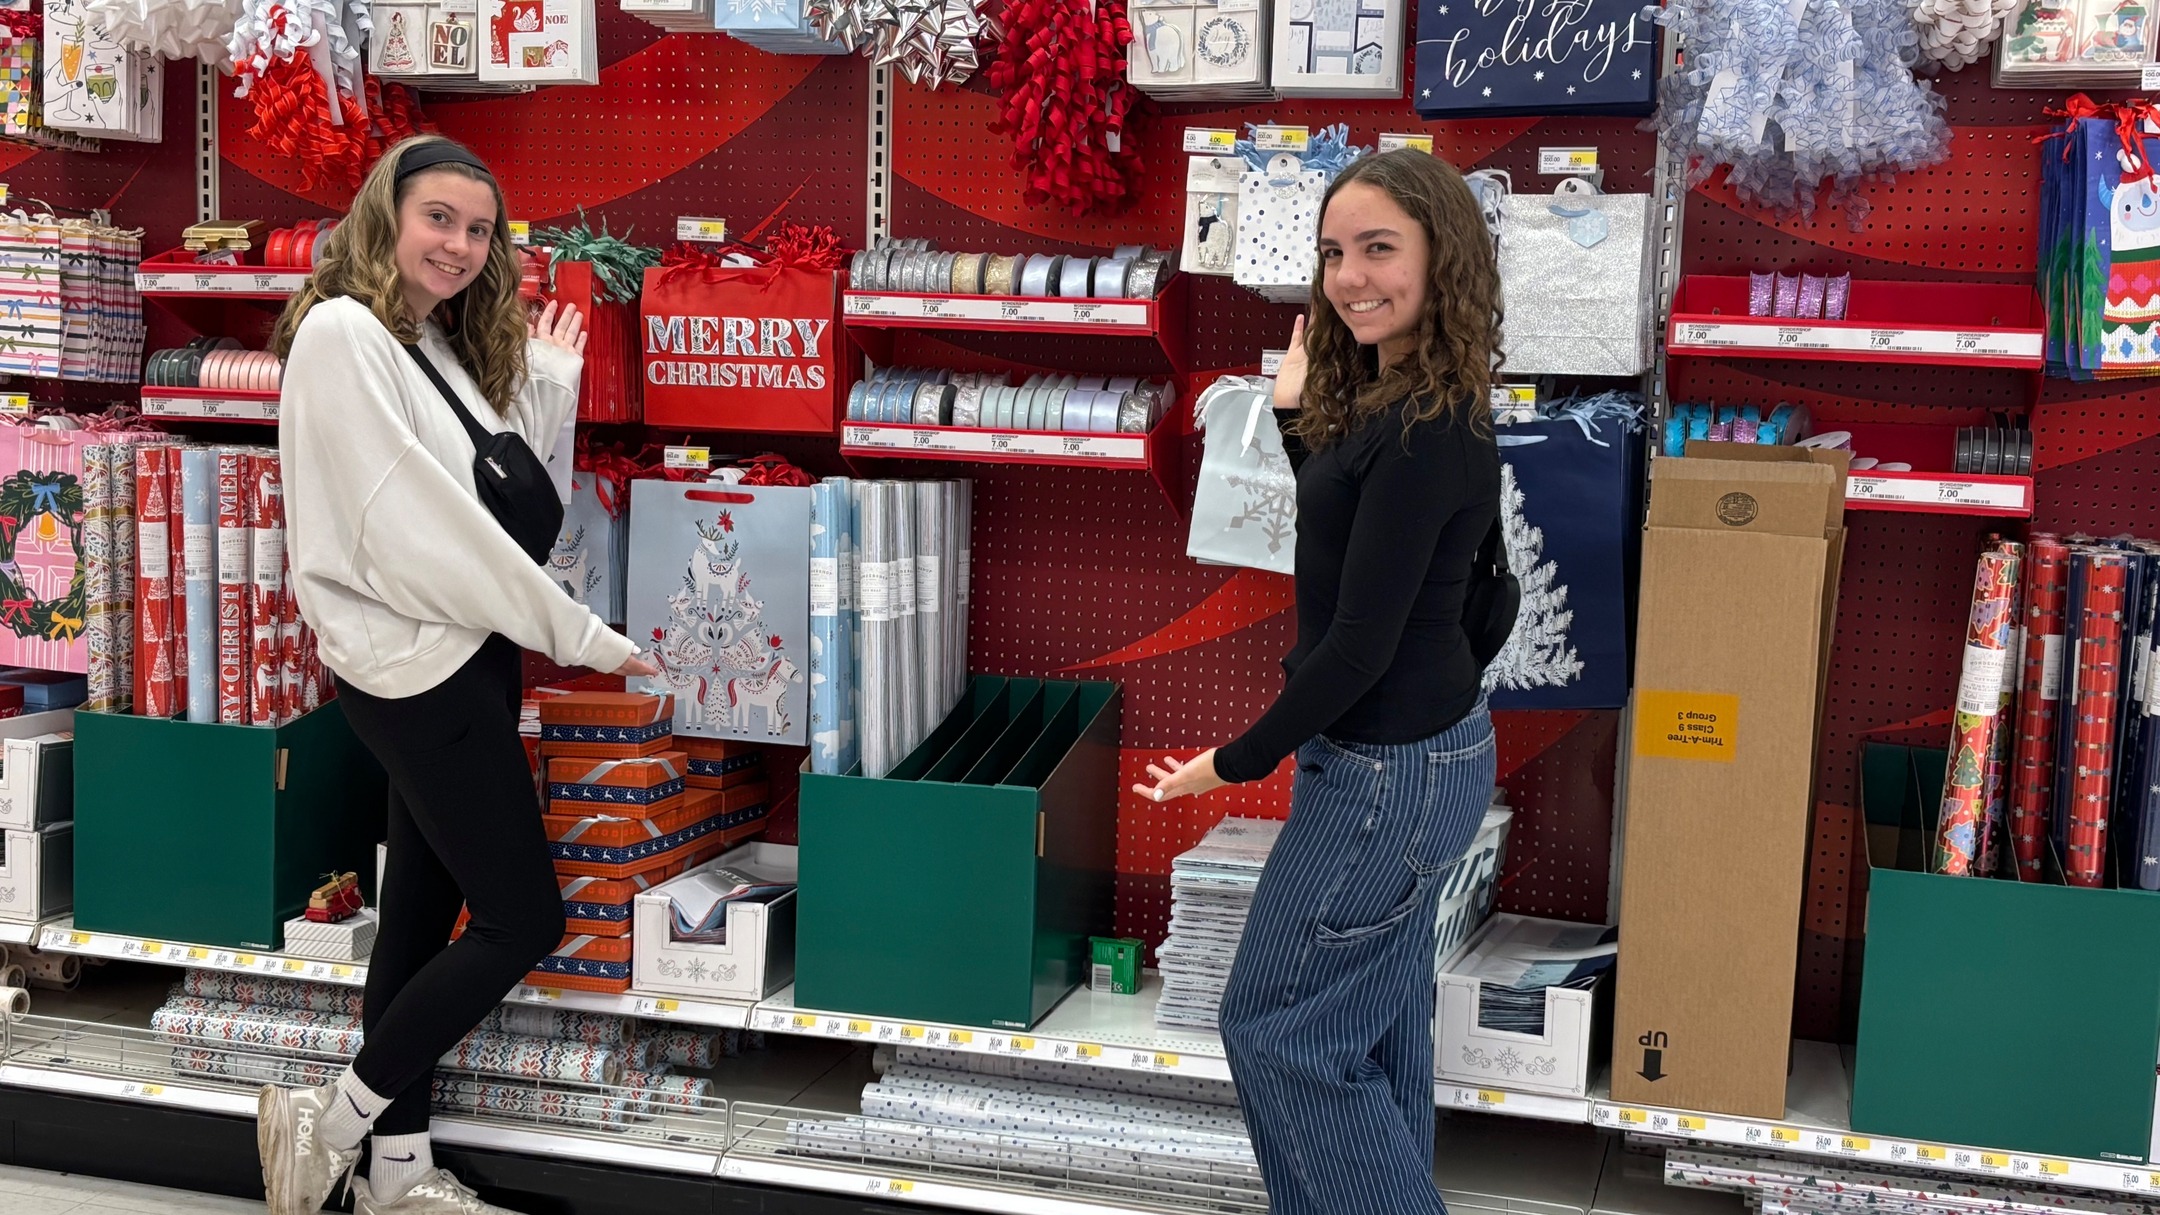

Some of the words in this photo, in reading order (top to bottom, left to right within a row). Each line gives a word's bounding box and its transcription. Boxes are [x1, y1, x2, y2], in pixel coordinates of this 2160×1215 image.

[1417, 4, 1652, 88] holidays
[854, 302, 871, 310] 7.00
[922, 305, 939, 313] 7.00
[1002, 307, 1018, 316] 7.00
[1073, 310, 1091, 318] 7.00
[645, 315, 830, 358] MERRY
[1687, 331, 1707, 339] 7.00
[1778, 334, 1798, 342] 7.00
[1870, 337, 1890, 345] 7.00
[1956, 340, 1976, 348] 7.00
[647, 360, 826, 390] CHRISTMAS
[913, 437, 930, 445] 7.00
[991, 440, 1008, 448] 7.00
[1063, 443, 1080, 451] 7.00
[219, 453, 238, 518] MER
[1853, 485, 1873, 493] 7.00
[1938, 489, 1958, 498] 7.00
[221, 583, 241, 683] CHRIST
[1677, 711, 1684, 720] 3
[1686, 711, 1717, 722] Group
[1678, 723, 1685, 731] 9
[1687, 723, 1714, 734] Class
[1667, 733, 1724, 746] Trim-A-Tree
[1638, 1030, 1668, 1048] UP
[1653, 1116, 1668, 1125] 24.00
[295, 1107, 314, 1156] HOKA
[1745, 1128, 1761, 1137] 24.00
[1770, 1130, 1783, 1139] 6.00
[1816, 1137, 1831, 1146] 24.00
[1891, 1146, 1906, 1155] 24.00
[1955, 1153, 1970, 1162] 24.00
[2013, 1160, 2028, 1169] 75.00
[2123, 1174, 2139, 1183] 75.00
